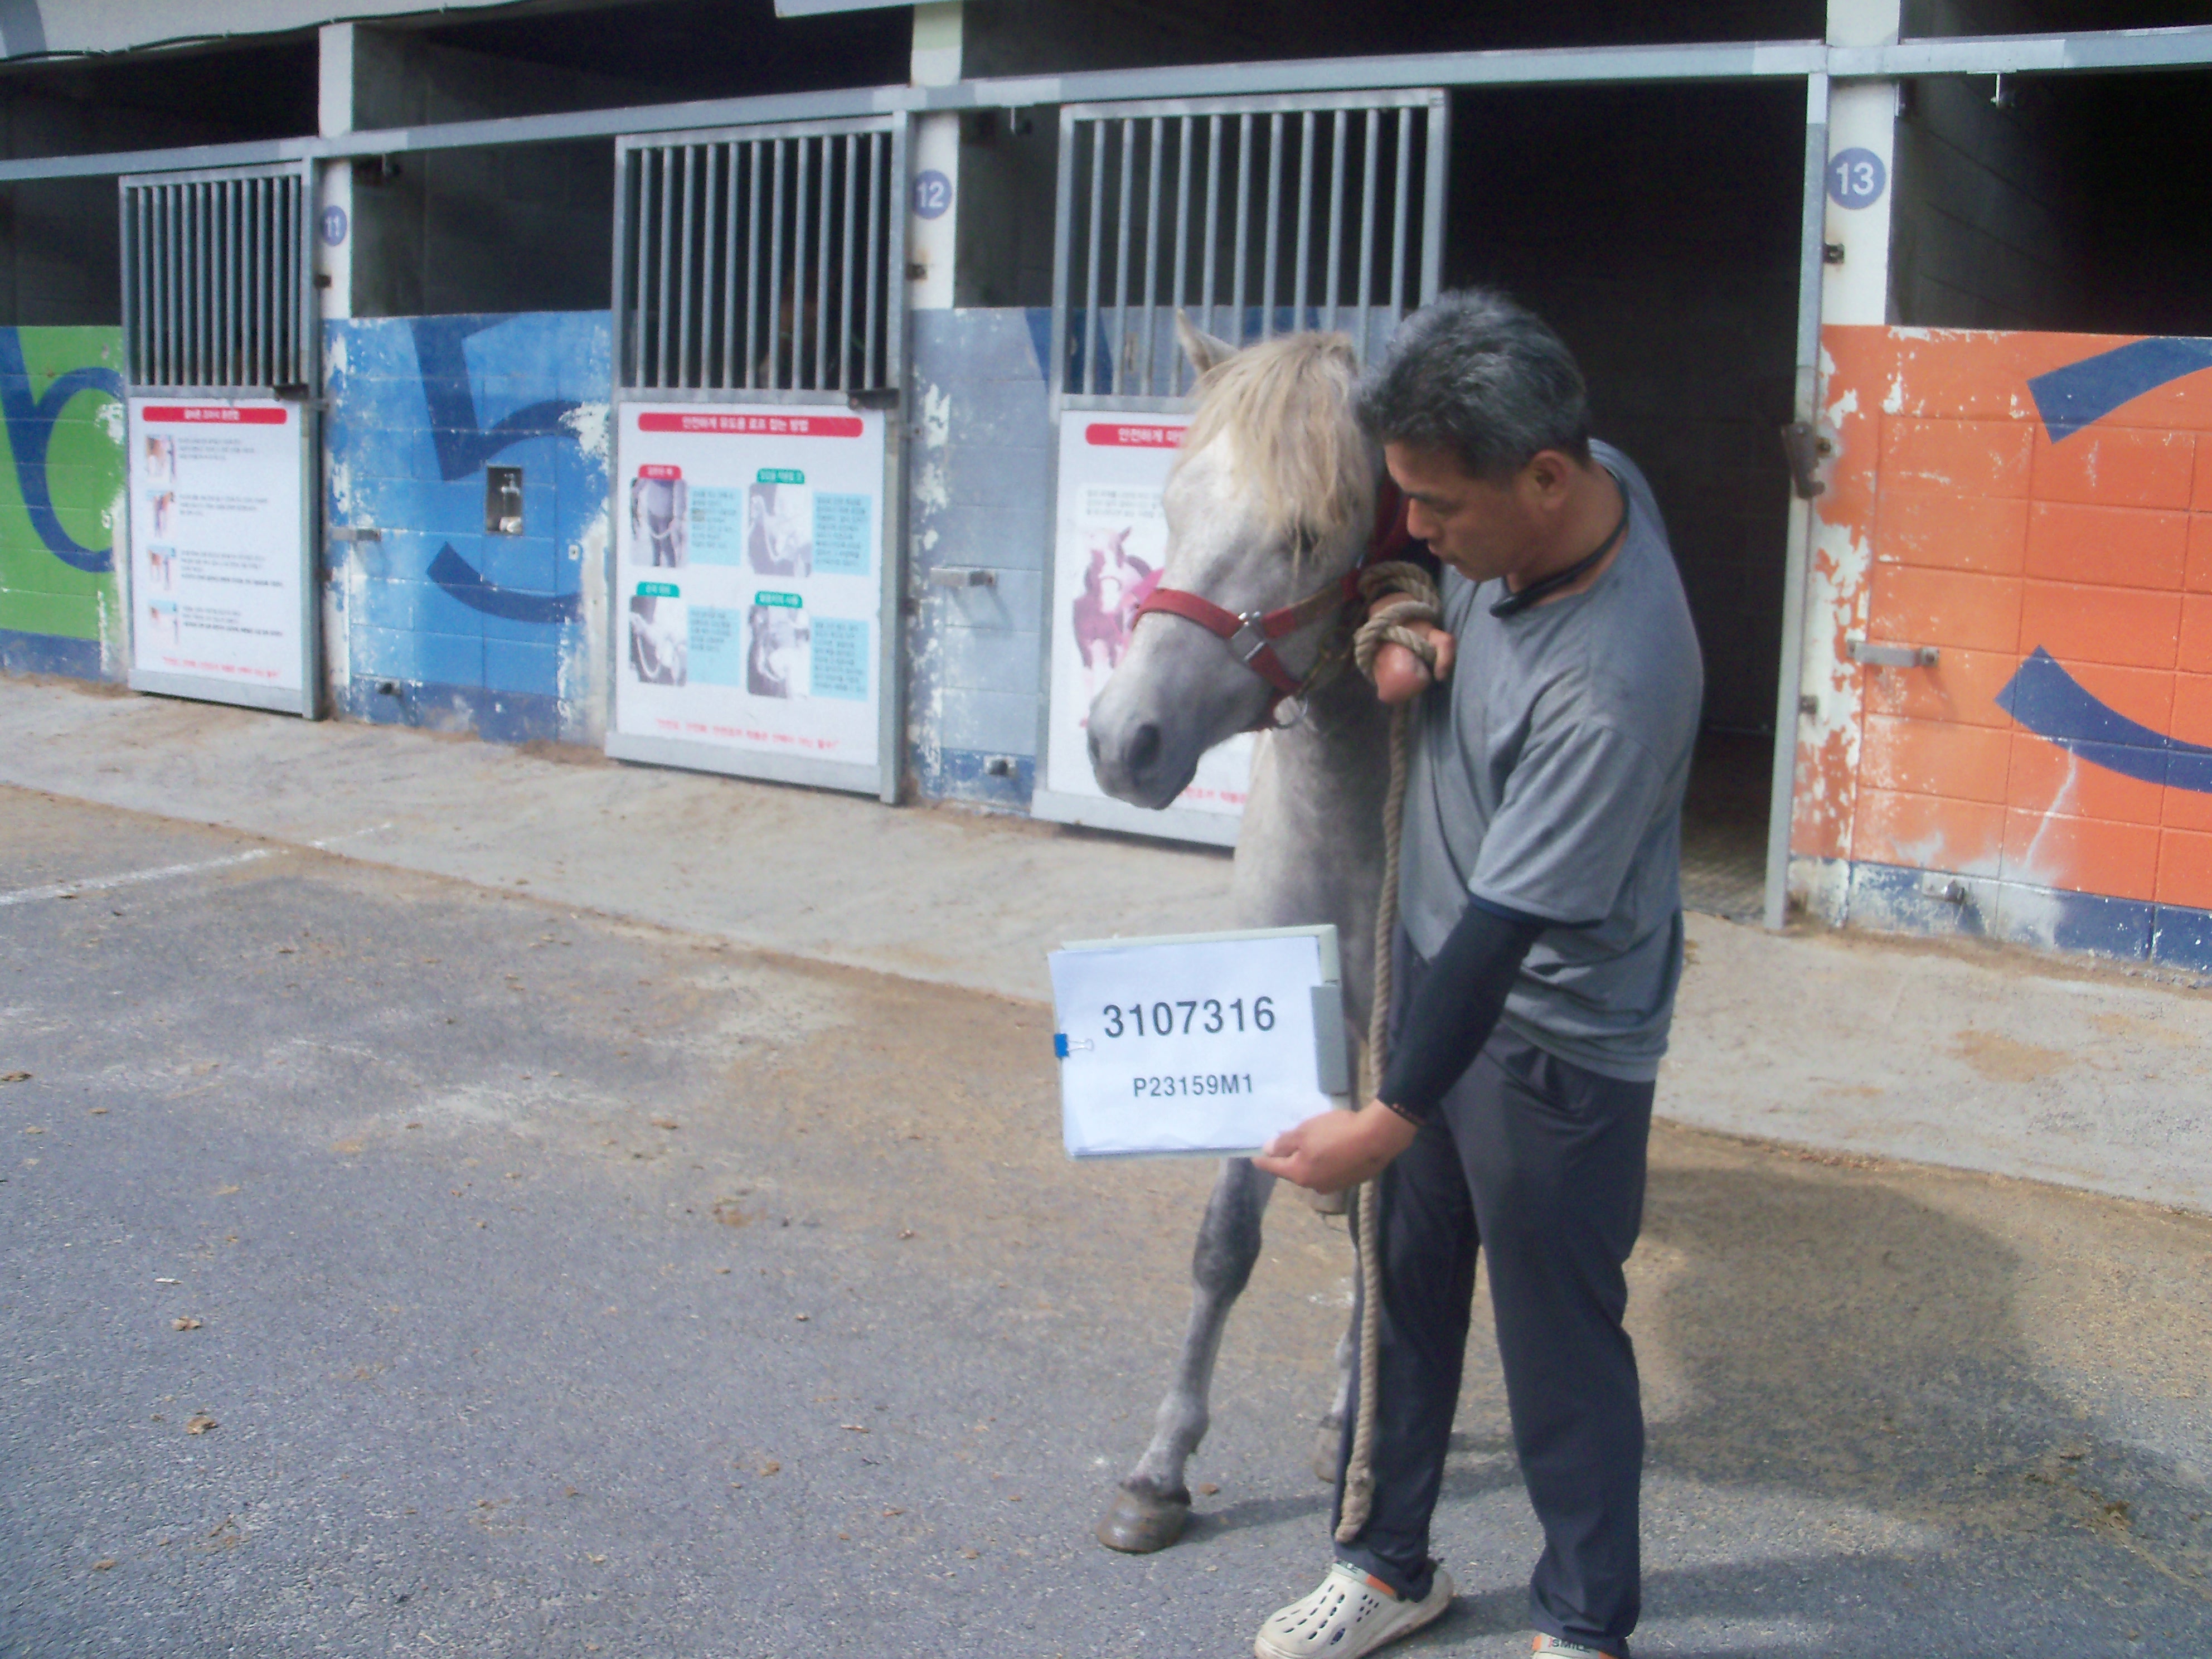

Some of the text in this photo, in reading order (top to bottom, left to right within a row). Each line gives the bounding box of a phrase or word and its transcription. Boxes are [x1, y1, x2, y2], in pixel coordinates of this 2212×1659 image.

[1836, 162, 1874, 196] 13
[917, 181, 945, 208] 12
[326, 215, 339, 237] 11
[1102, 996, 1276, 1039] 3107316
[1133, 1074, 1253, 1097] P23159M1
